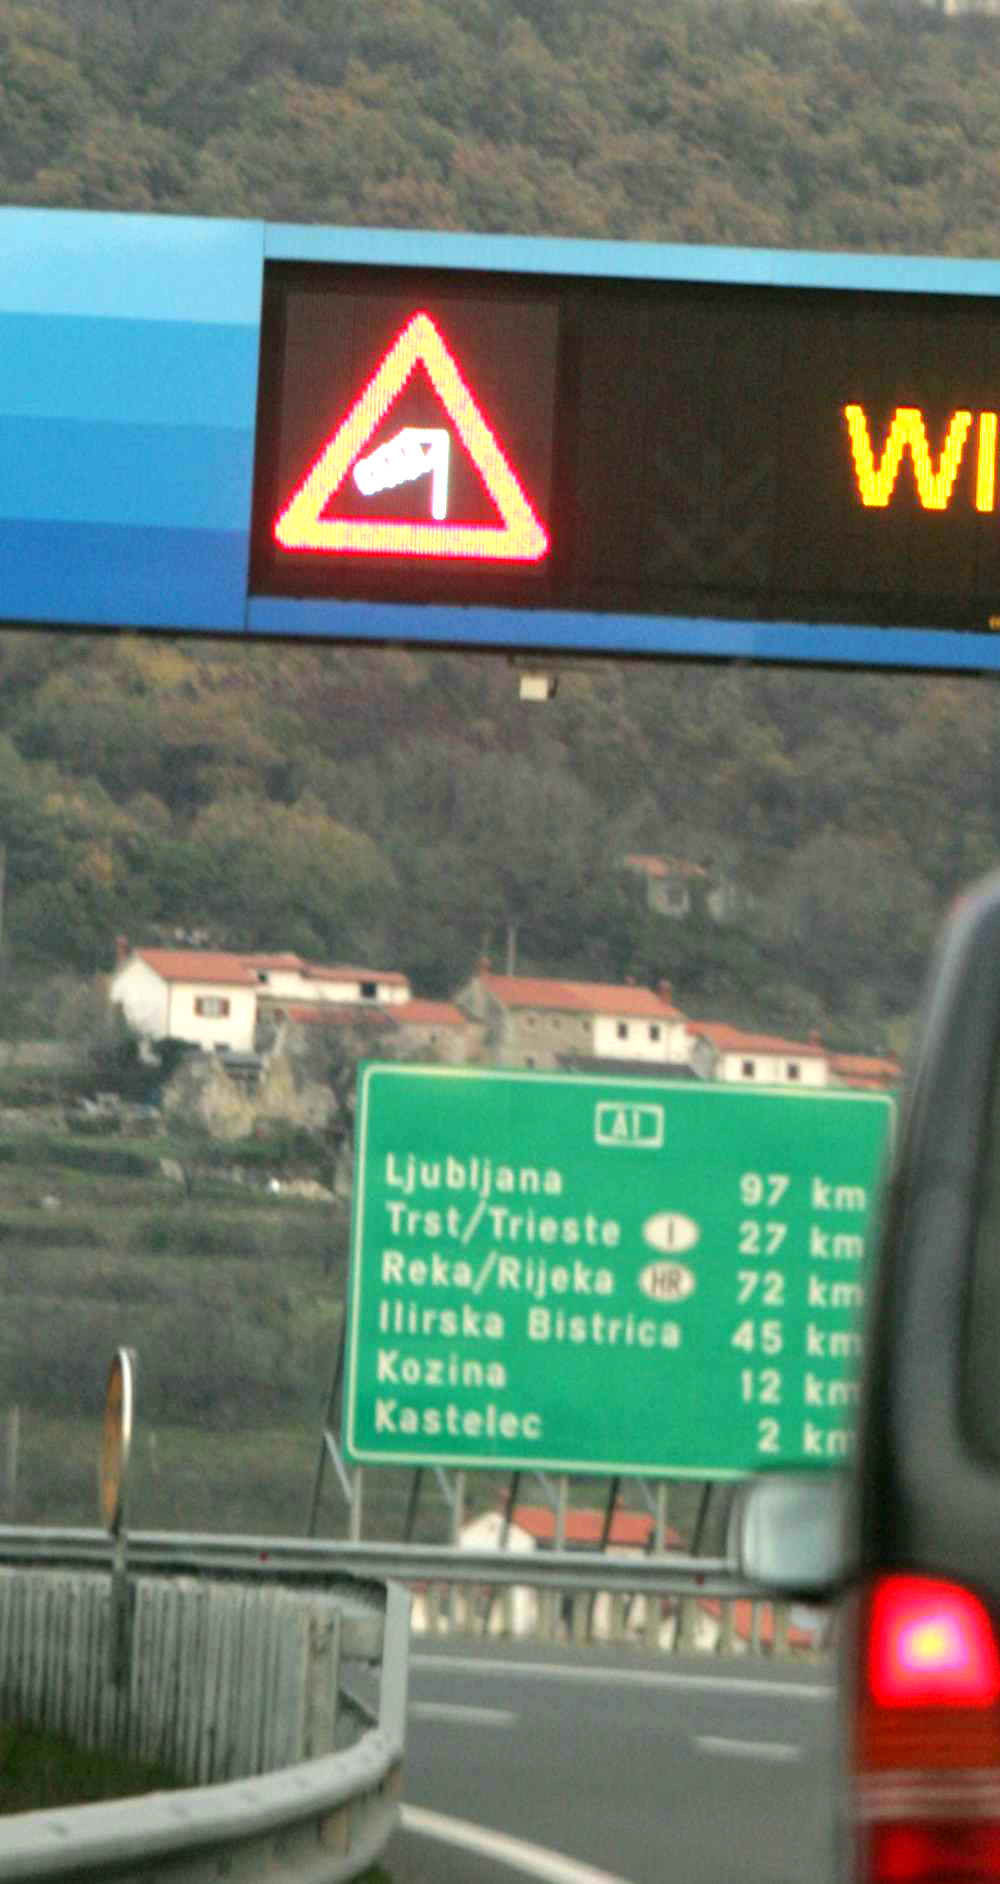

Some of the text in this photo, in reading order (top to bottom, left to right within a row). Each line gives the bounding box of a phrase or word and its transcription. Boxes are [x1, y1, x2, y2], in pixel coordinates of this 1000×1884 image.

[612, 1108, 641, 1138] A1
[385, 1151, 867, 1212] Ljubljana 97 km
[385, 1199, 622, 1247] Trst/Trieste
[738, 1219, 788, 1255] 27
[810, 1224, 865, 1260] km
[381, 1249, 615, 1302] Reka/Rijeka
[737, 1270, 785, 1306] 72
[808, 1274, 866, 1309] km
[379, 1299, 505, 1339] Ilirska
[527, 1306, 681, 1350] Bistrica
[731, 1319, 783, 1355] 45
[376, 1349, 508, 1389] Kozina
[741, 1368, 781, 1404] 12
[374, 1397, 542, 1440] Kastelec
[757, 1416, 781, 1453] 2
